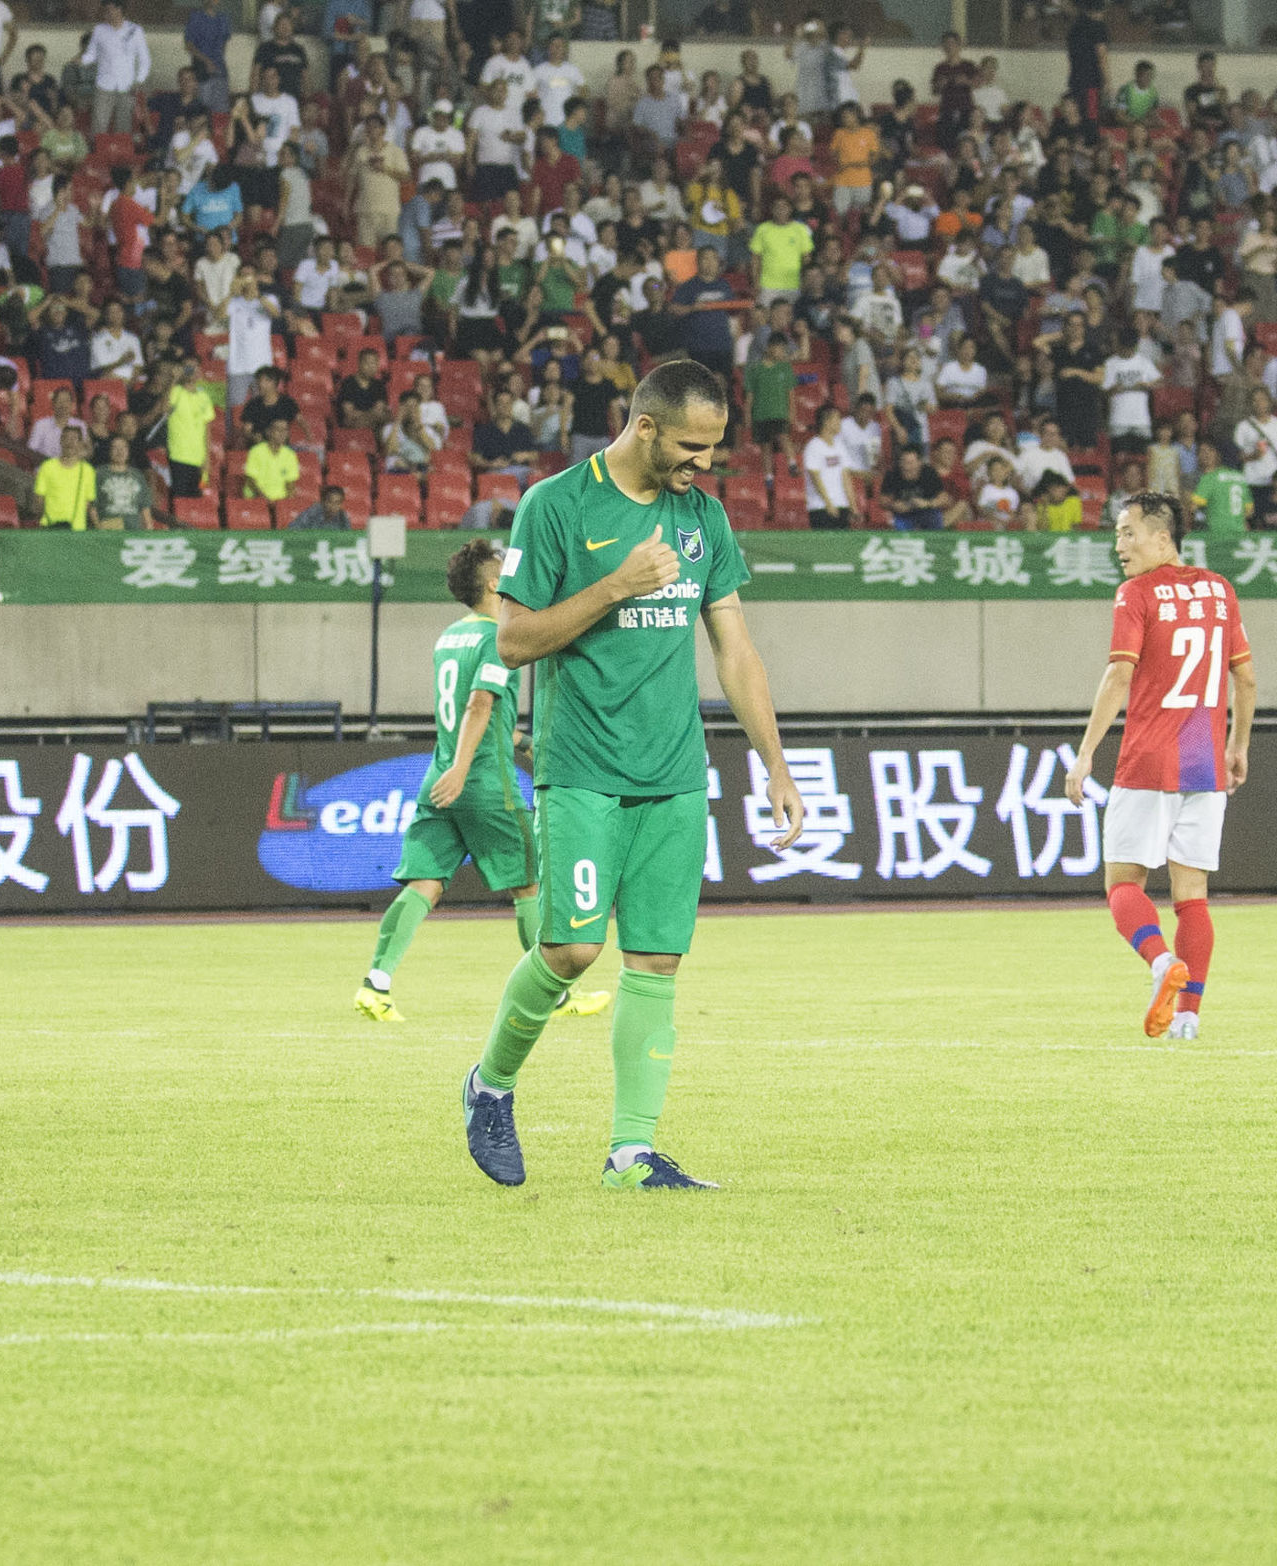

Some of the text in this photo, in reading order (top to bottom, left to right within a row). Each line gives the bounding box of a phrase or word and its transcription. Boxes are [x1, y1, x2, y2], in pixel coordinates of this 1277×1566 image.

[617, 605, 689, 629] 松下洁乐
[437, 658, 460, 733] 8
[1160, 625, 1224, 709] 21
[573, 858, 598, 911] 9
